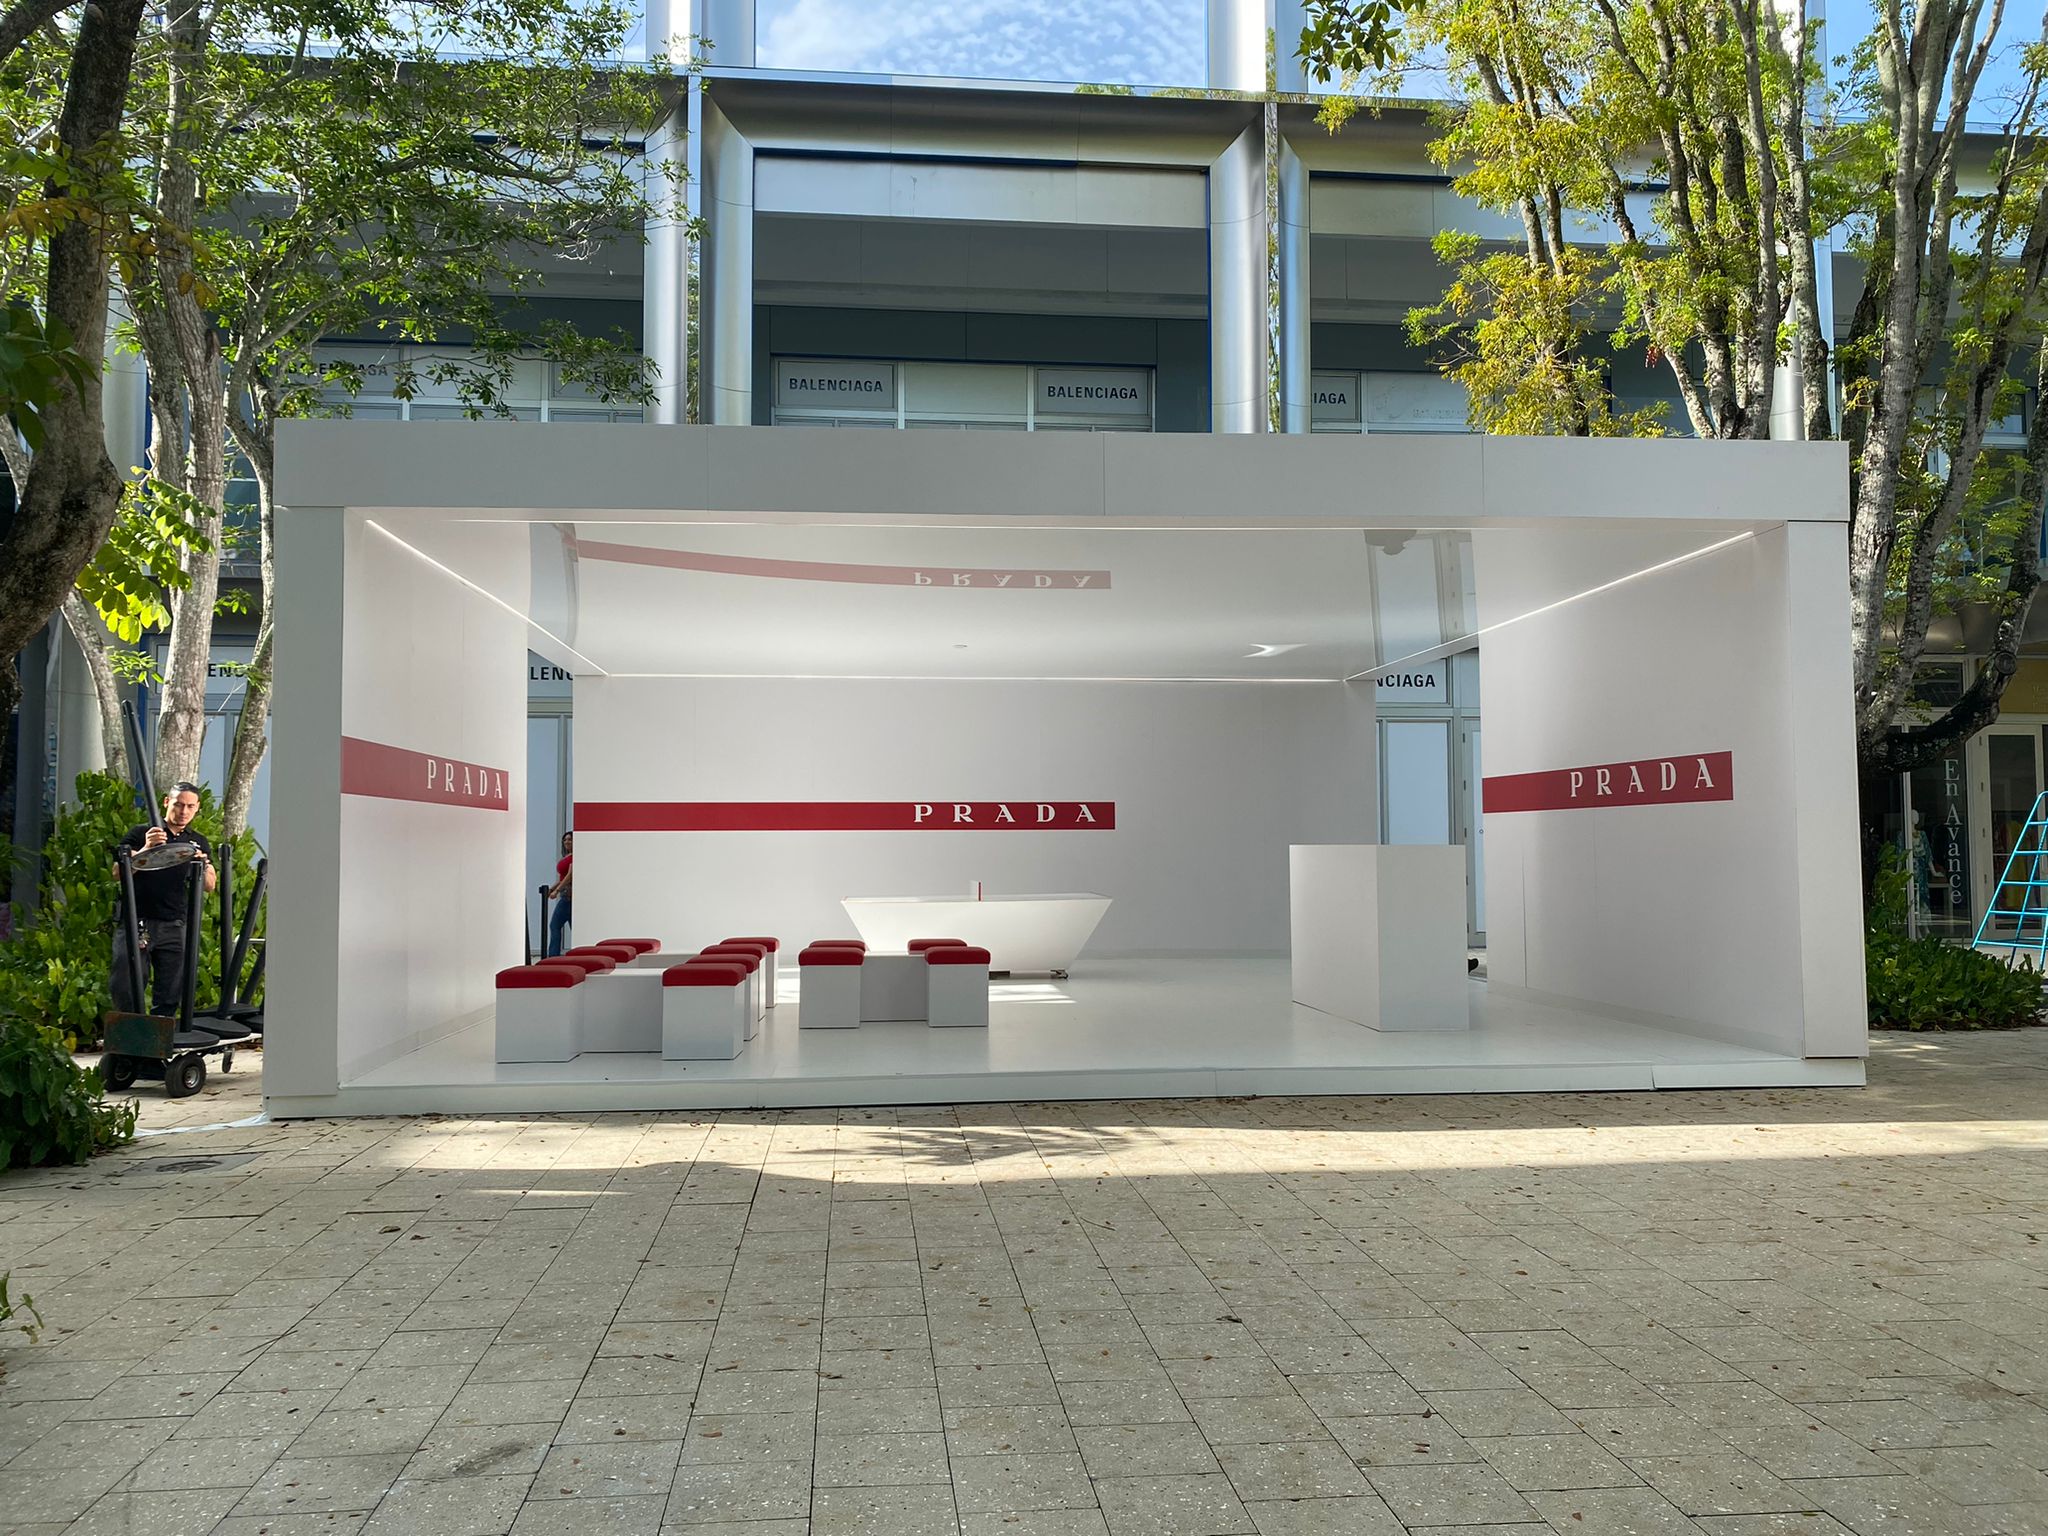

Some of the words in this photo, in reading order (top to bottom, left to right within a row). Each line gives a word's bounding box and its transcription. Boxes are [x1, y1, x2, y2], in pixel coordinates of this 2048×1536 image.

[789, 378, 883, 392] BALENCIAGA
[1047, 385, 1138, 399] BALENCIAGA
[427, 759, 503, 799] PRADA
[1569, 758, 1715, 798] PRADA
[1943, 759, 1960, 797] En
[913, 804, 1097, 823] PRADA
[1943, 803, 1963, 904] Avance
